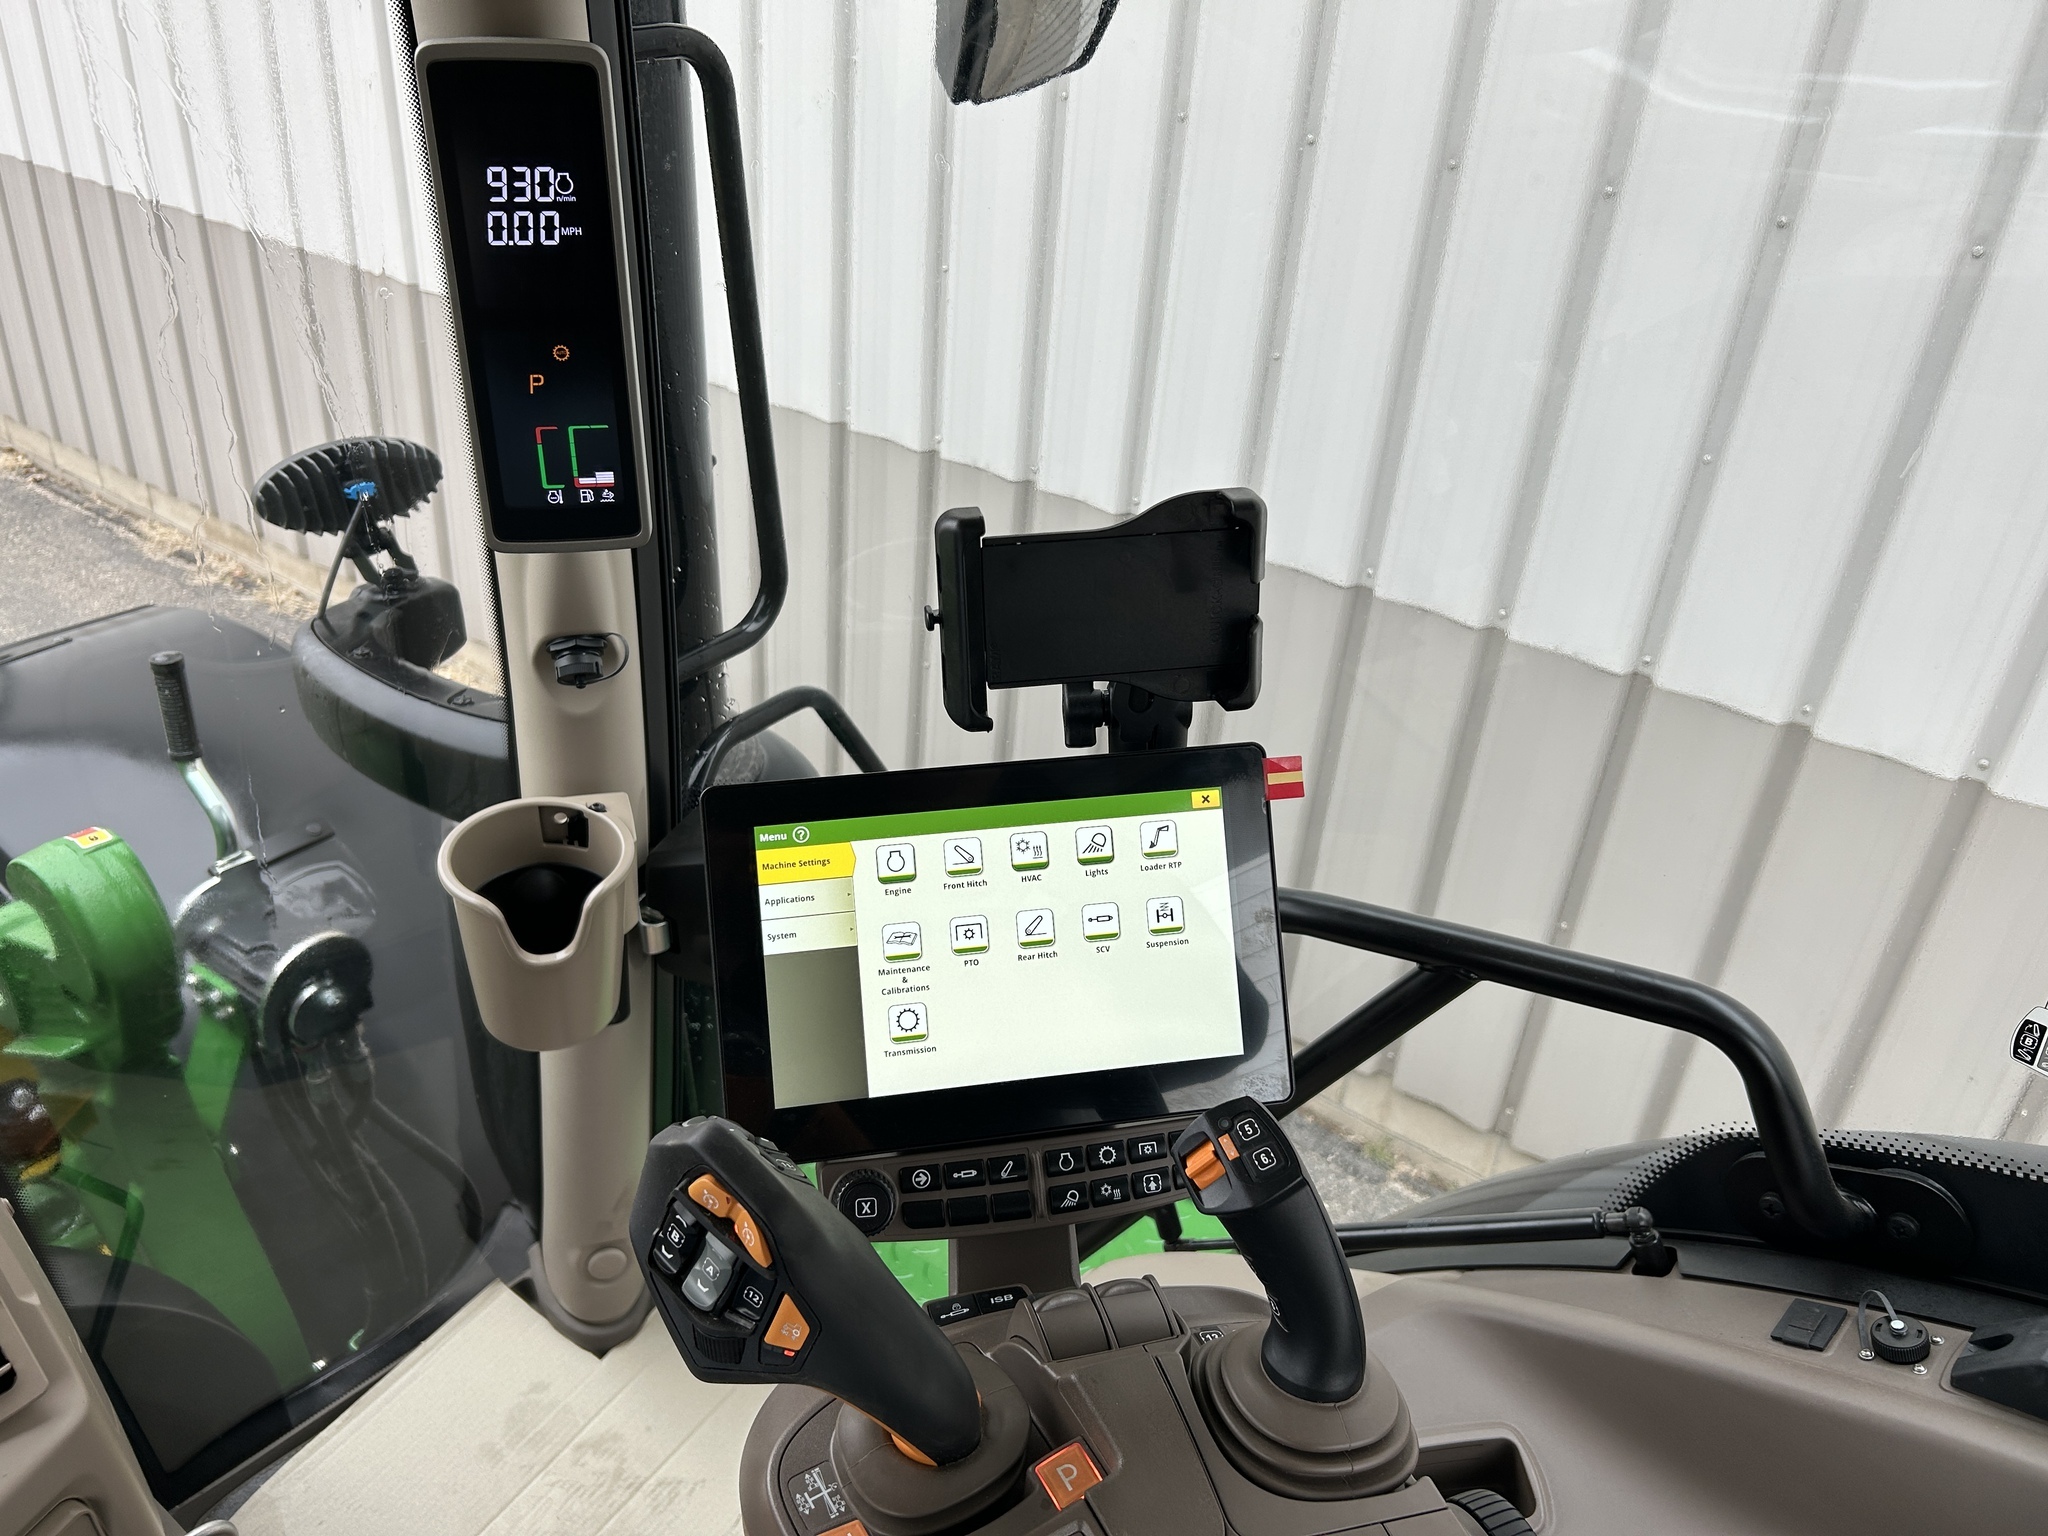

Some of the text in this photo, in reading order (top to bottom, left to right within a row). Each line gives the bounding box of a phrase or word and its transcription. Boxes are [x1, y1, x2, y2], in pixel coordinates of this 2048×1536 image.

[486, 166, 555, 202] 930
[487, 210, 582, 246] 0.00 MPH
[529, 374, 545, 394] P
[759, 832, 788, 843] Menu
[762, 857, 831, 870] Machine Settings
[1140, 861, 1182, 872] Loader RTP
[1021, 874, 1043, 883] HVAC
[1085, 867, 1109, 878] Lights
[943, 879, 988, 890] Front Hitch
[884, 886, 912, 897] Engine
[764, 894, 815, 907] Applications
[767, 931, 797, 942] System
[1095, 945, 1111, 953] SCV
[1145, 937, 1190, 949] Suspension
[1017, 950, 1058, 962] Rear Hitch
[963, 958, 980, 967] PTO
[877, 964, 931, 976] Maintenance
[881, 984, 930, 996] Calibrations
[2024, 1036, 2034, 1046] B
[883, 1045, 937, 1058] Transmission
[1244, 1123, 1253, 1135] 5
[861, 1201, 871, 1214] X
[670, 1229, 680, 1243] B
[705, 1265, 714, 1276] A
[748, 1290, 760, 1304] 12
[990, 1293, 1014, 1304] ISB
[1056, 1463, 1078, 1492] P
